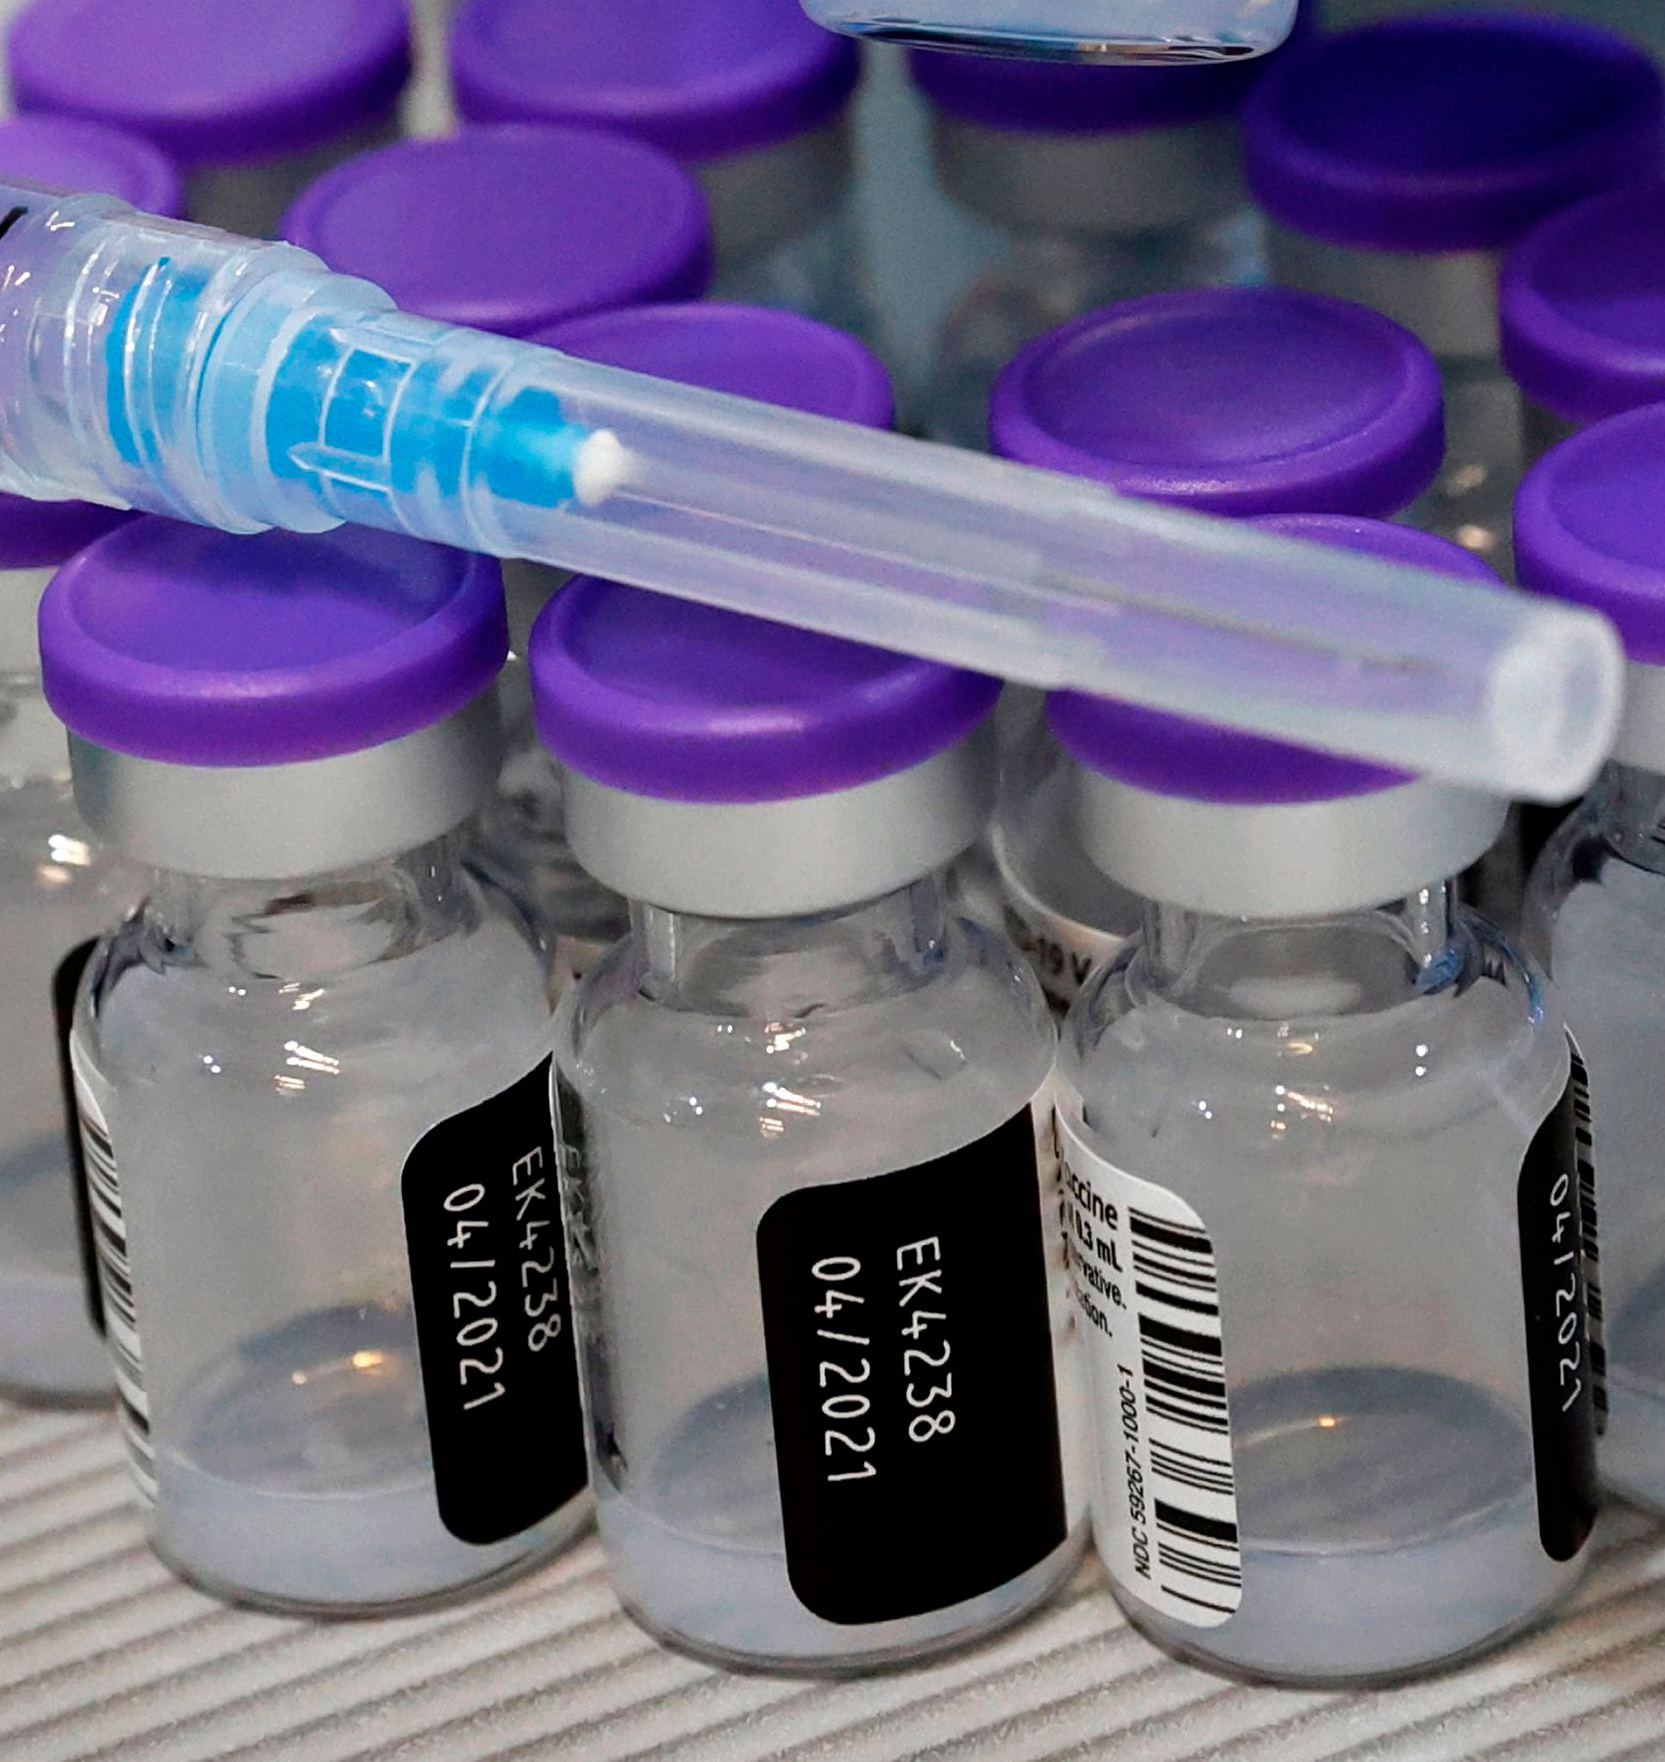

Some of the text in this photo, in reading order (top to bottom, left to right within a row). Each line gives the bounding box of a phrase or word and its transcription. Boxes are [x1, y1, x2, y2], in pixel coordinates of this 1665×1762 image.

[443, 1183, 506, 1410] 04/2021
[512, 1145, 562, 1352] EK4238
[896, 1235, 956, 1443] EK4238
[1096, 1236, 1123, 1273] mL
[1549, 1173, 1582, 1412] 04/2021
[811, 1256, 877, 1482] 04/2021
[1117, 1362, 1152, 1581] NDC 59267-1000-1
